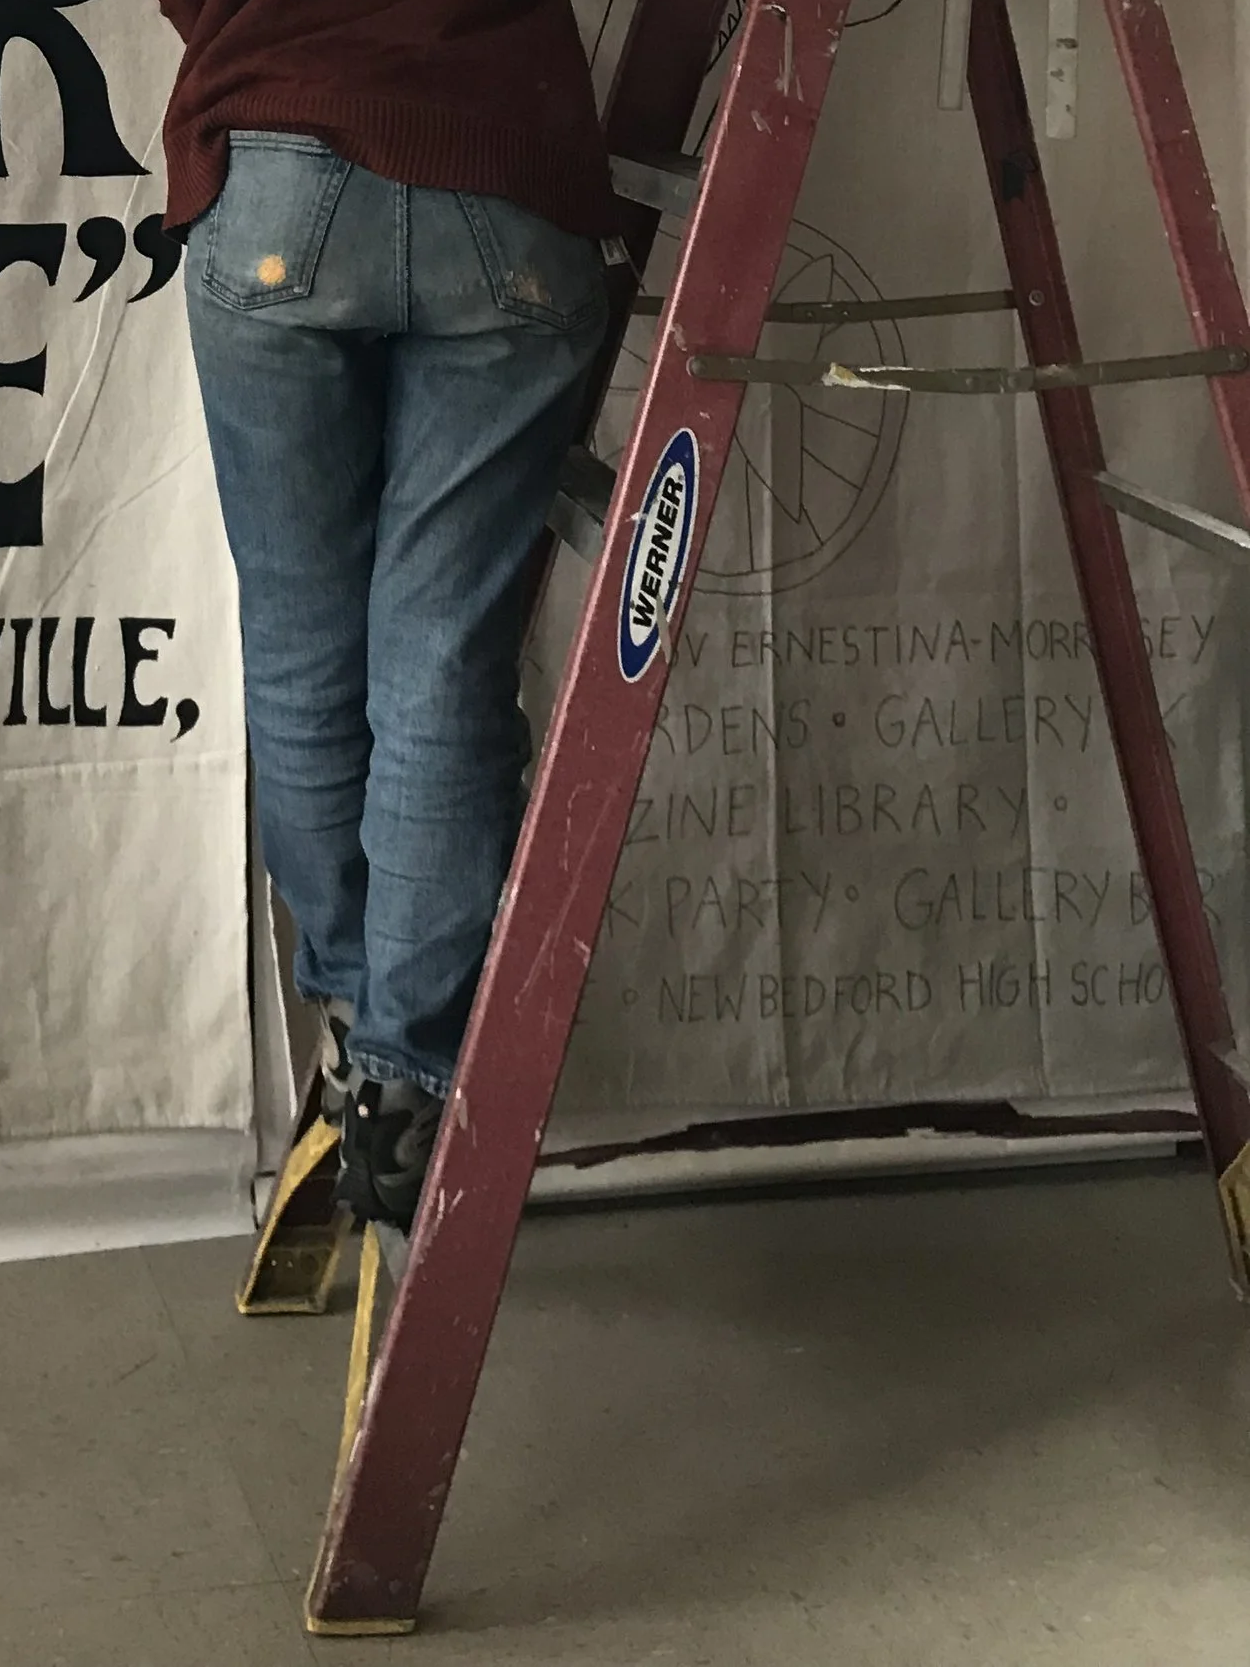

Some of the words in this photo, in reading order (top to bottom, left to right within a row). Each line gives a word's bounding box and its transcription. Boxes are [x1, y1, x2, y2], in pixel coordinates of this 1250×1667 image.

[633, 477, 684, 627] WERNER
[874, 695, 1093, 752] GALLERY
[784, 784, 1027, 837] LIBRARY
[666, 871, 831, 936] PARTY
[895, 868, 1109, 931] GALLERY
[1130, 869, 1222, 927] BR
[659, 973, 749, 1022] NEW
[760, 970, 933, 1019] BEDFORD
[958, 960, 1051, 1012] HIGH
